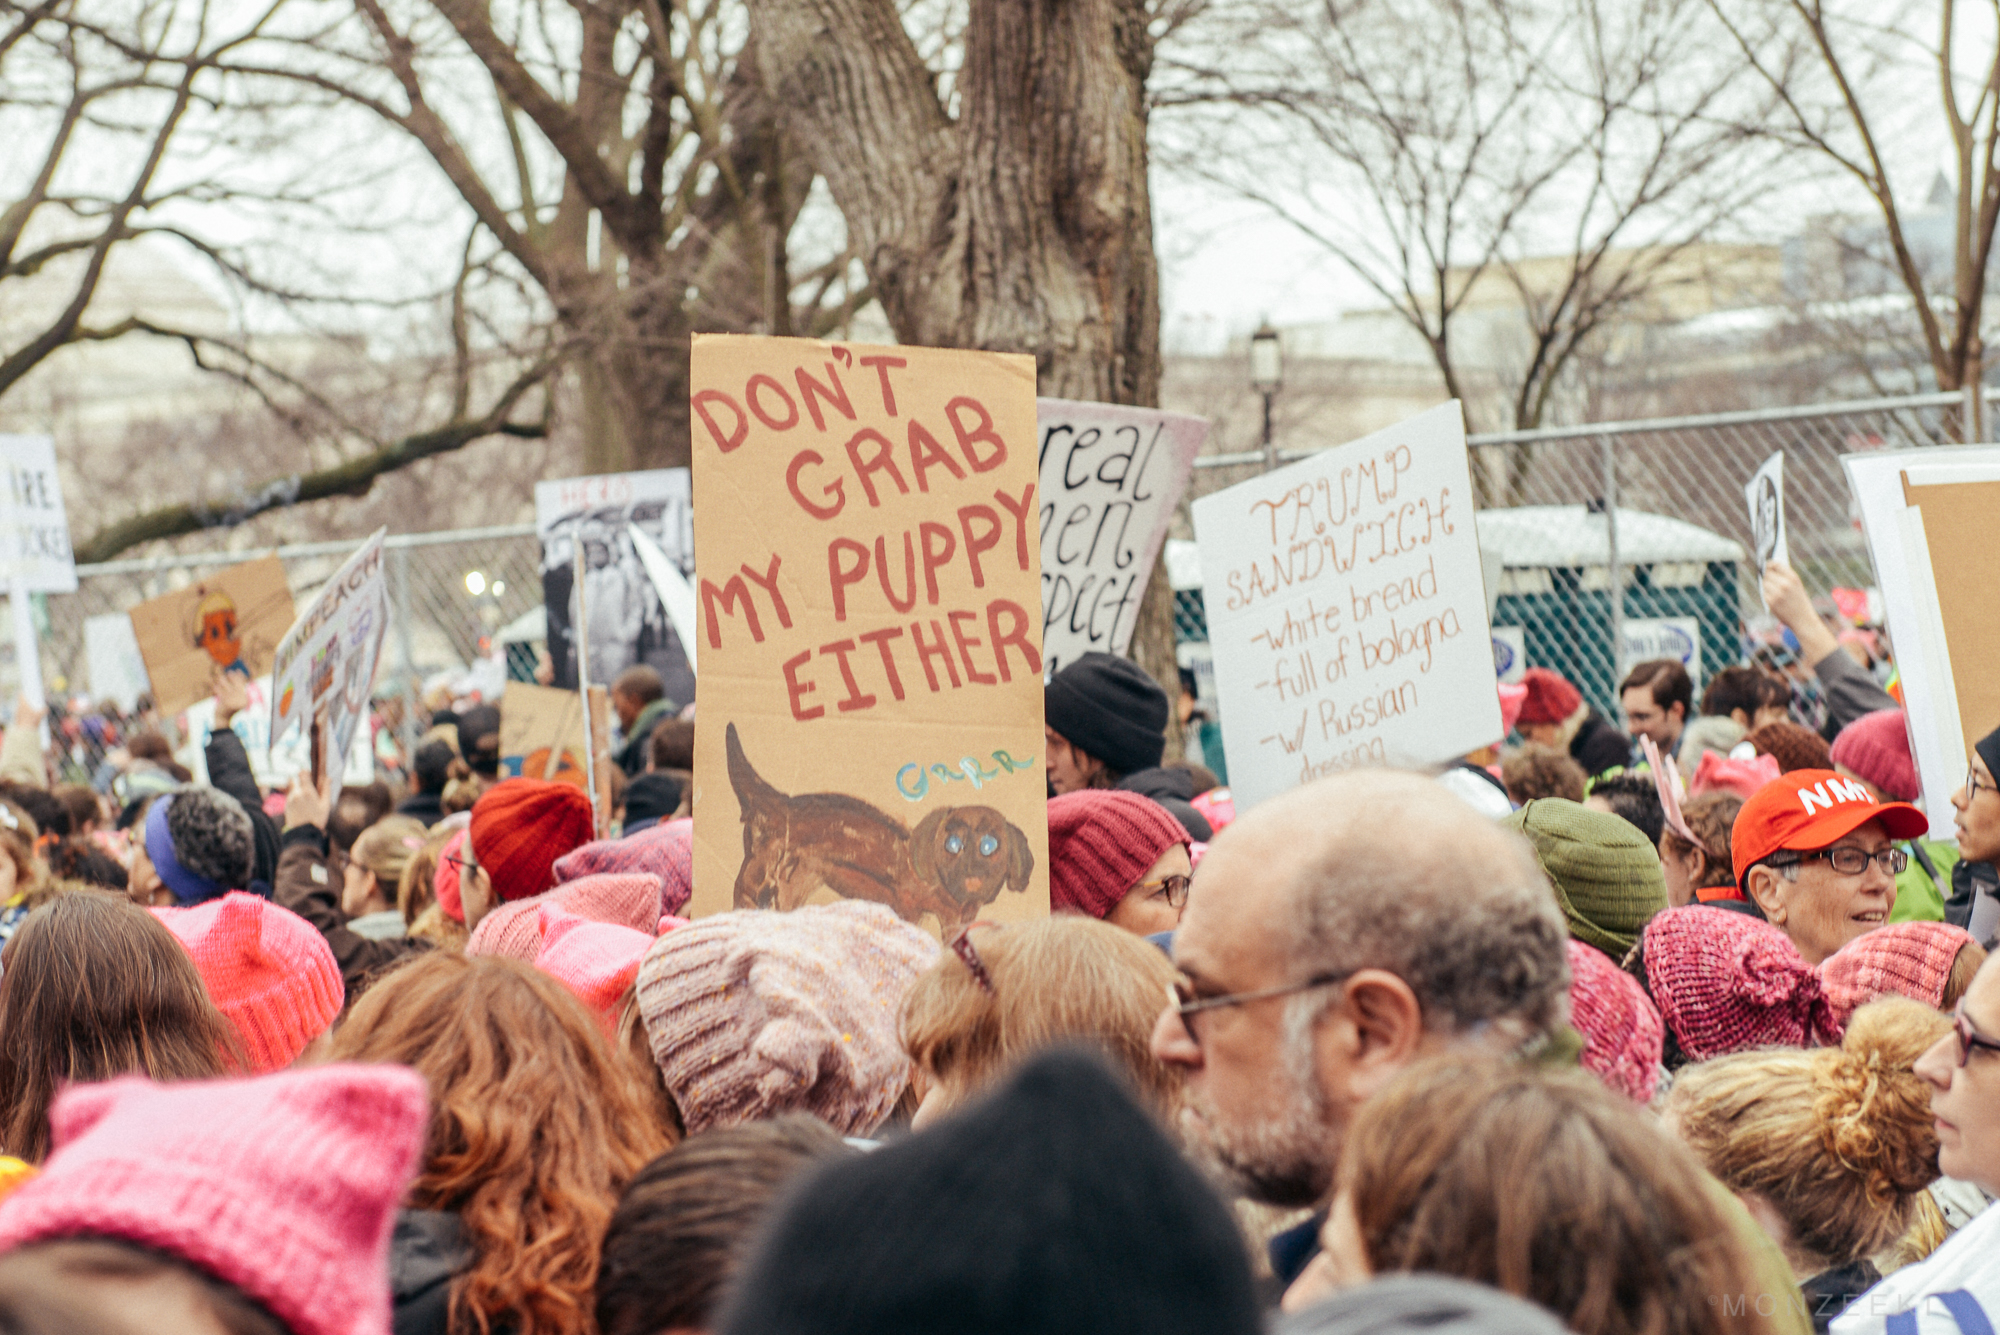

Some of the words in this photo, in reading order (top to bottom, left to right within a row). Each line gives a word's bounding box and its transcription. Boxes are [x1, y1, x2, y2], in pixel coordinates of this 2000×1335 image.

[691, 346, 907, 453] DON'T
[786, 396, 1008, 521] GRAB
[1039, 421, 1164, 501] real
[1250, 444, 1412, 546] TRUMP
[701, 552, 793, 650] MY
[828, 482, 1036, 622] PUPPY
[1227, 487, 1454, 612] SANDWICH
[1350, 553, 1438, 623] bread
[782, 598, 1042, 721] EITHER
[1326, 635, 1349, 684] of
[1359, 607, 1462, 674] bologna
[1319, 680, 1418, 742] Russian
